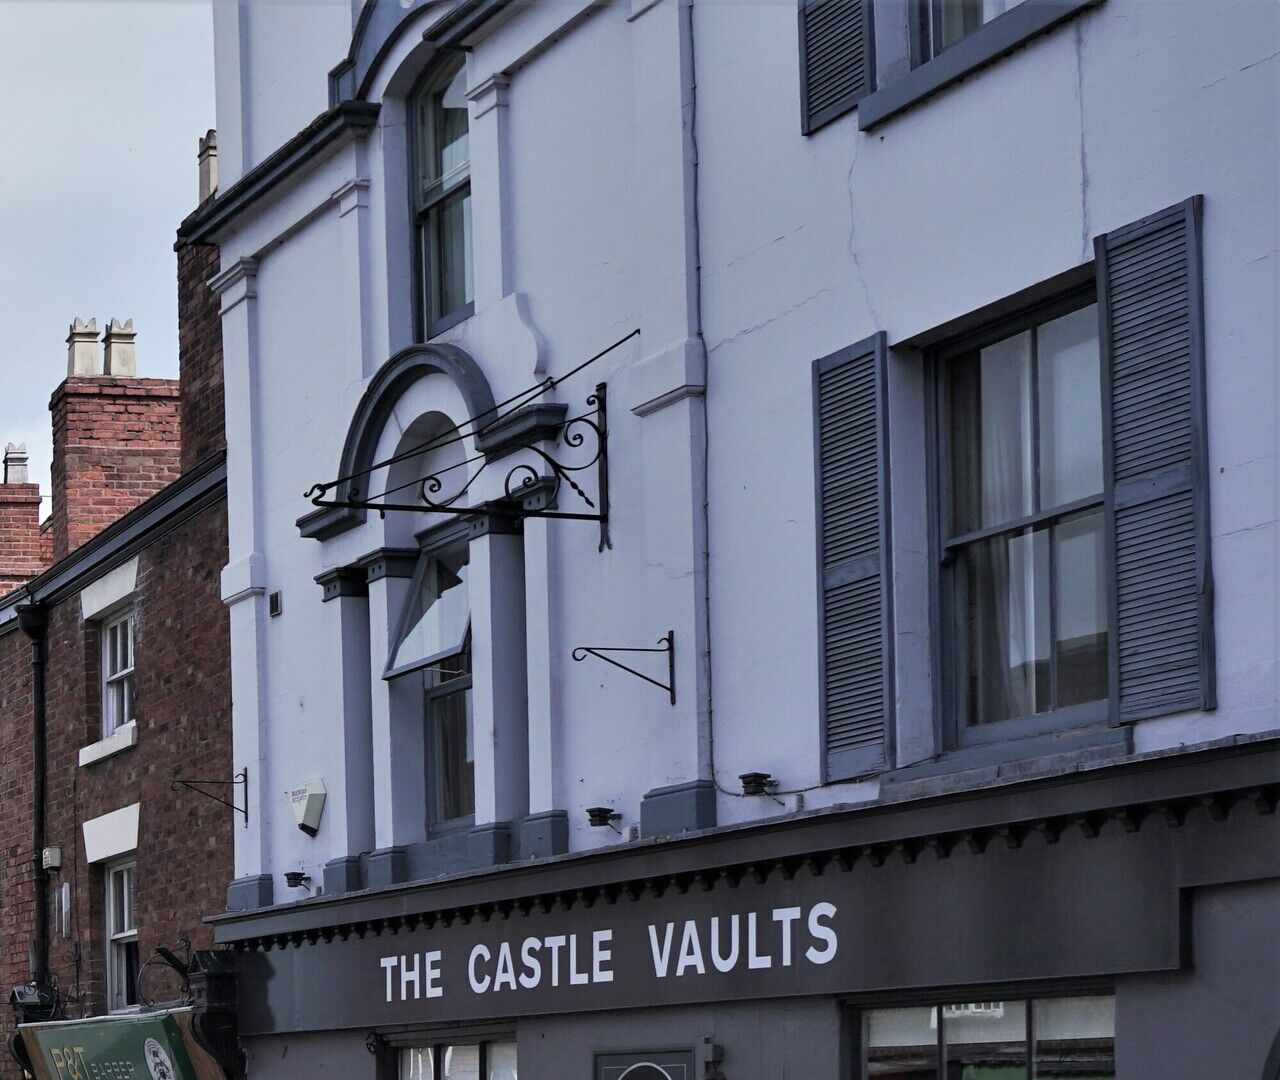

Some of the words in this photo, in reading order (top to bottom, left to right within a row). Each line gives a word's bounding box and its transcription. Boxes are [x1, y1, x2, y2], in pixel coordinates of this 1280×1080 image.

[380, 950, 443, 1002] THE
[468, 929, 614, 994] CASTLE
[648, 901, 839, 979] VAULTS
[49, 1046, 90, 1080] P&T
[90, 1061, 134, 1080] BARBER
